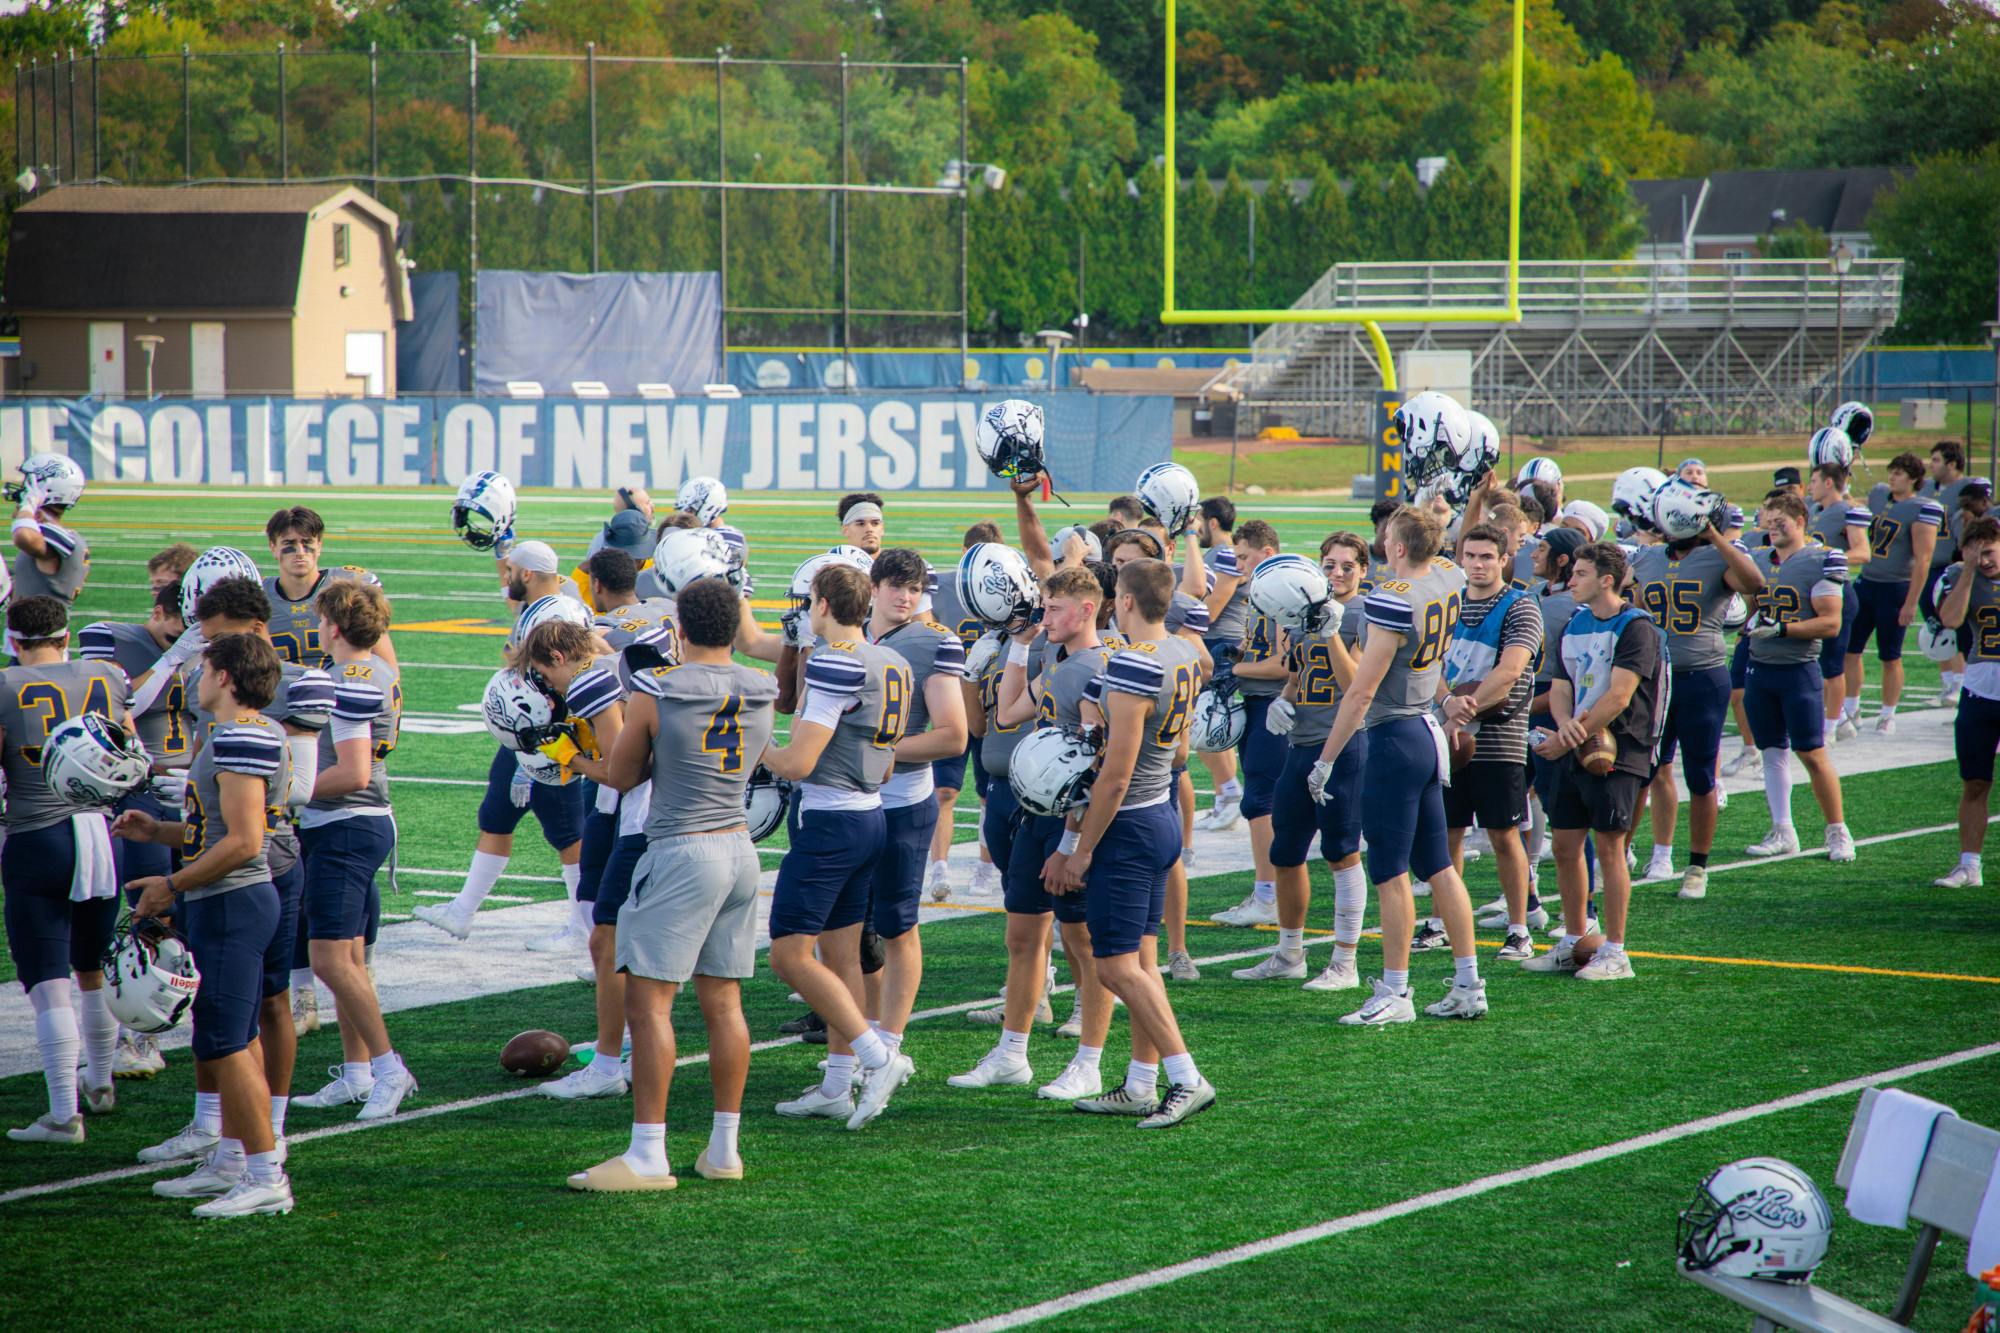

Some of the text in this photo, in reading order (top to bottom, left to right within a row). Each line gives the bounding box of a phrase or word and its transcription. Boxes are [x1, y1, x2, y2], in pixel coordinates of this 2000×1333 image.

[91, 404, 421, 486] COLLEGE
[442, 403, 537, 488] OF
[553, 404, 729, 488] NEW
[742, 401, 999, 489] JERSEY
[1382, 401, 1401, 497] TCNJ
[984, 562, 1013, 605] Lions
[1382, 580, 1411, 594] 88
[1644, 580, 1702, 634] 95
[1410, 591, 1461, 671] 88
[343, 664, 374, 680] 37
[873, 665, 915, 749] 81
[1296, 644, 1335, 704] 12
[18, 676, 113, 767] 34
[702, 694, 745, 774] 4
[1733, 1186, 1806, 1228] Lions
